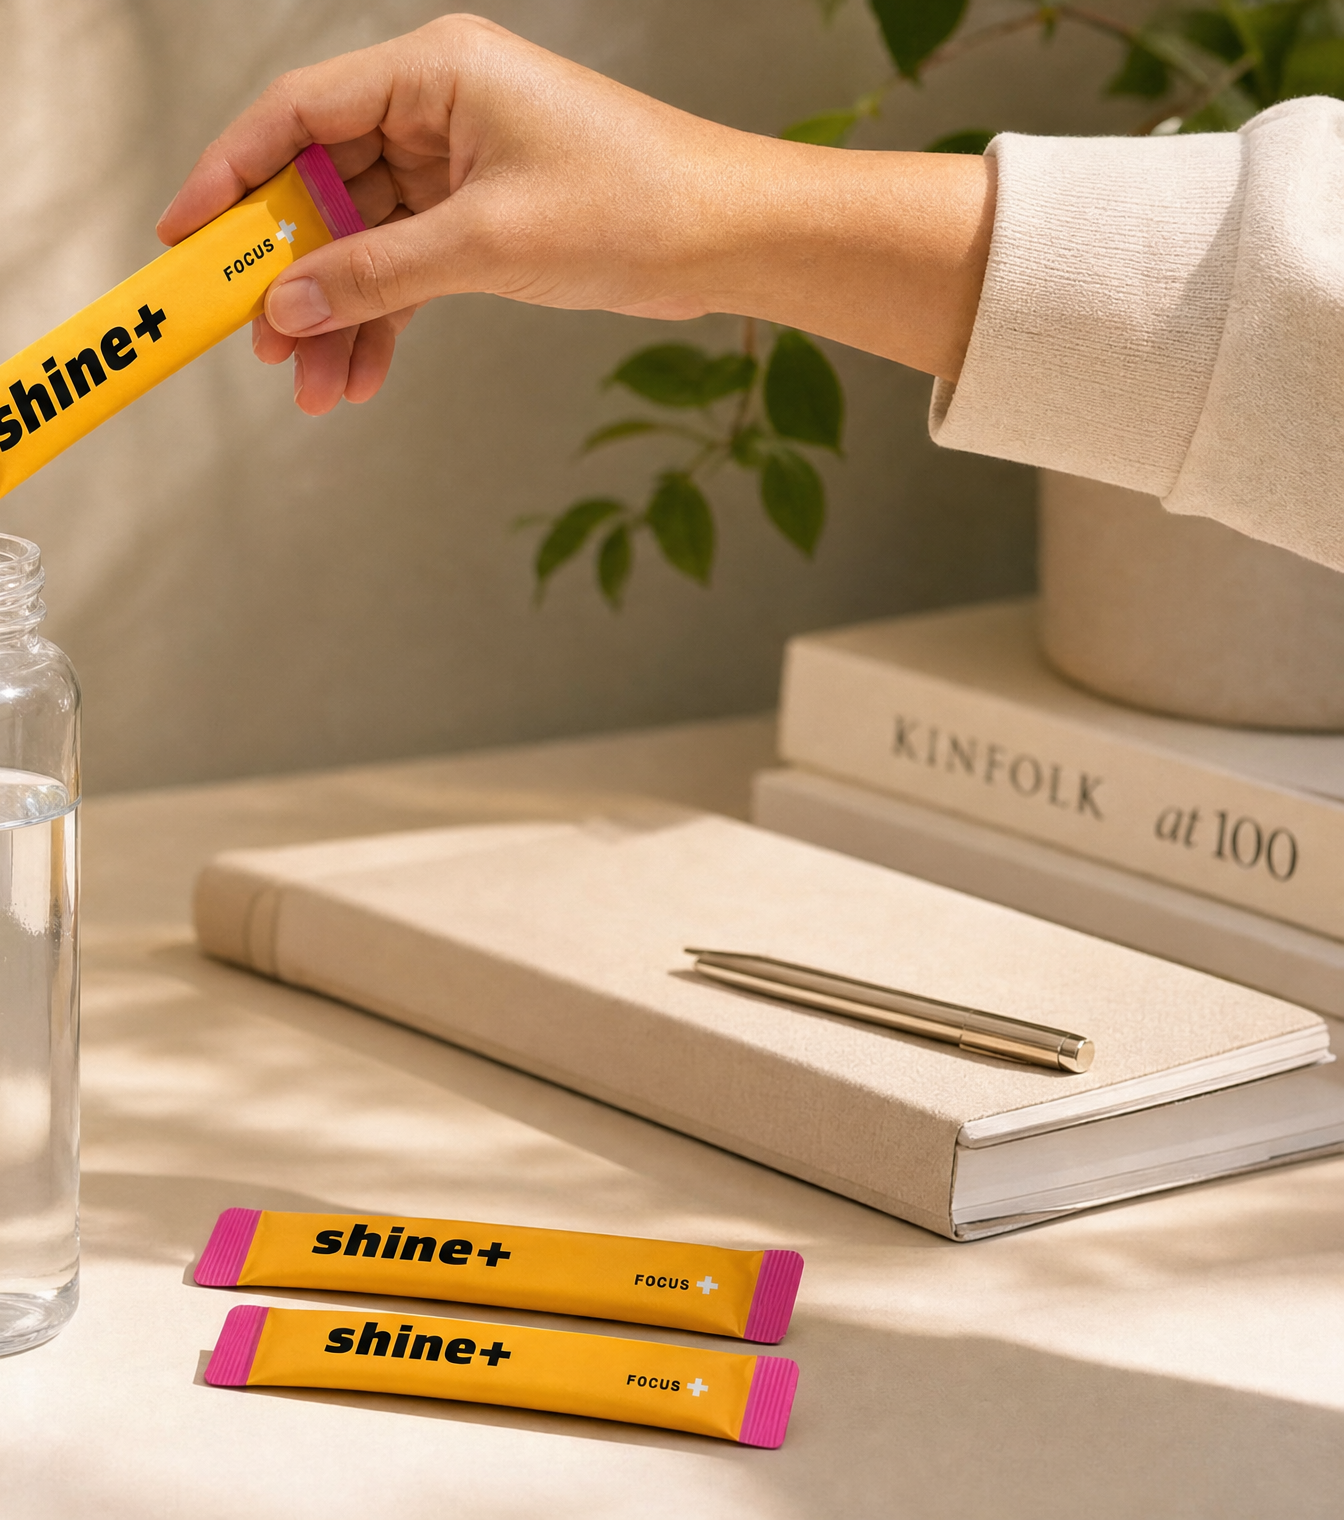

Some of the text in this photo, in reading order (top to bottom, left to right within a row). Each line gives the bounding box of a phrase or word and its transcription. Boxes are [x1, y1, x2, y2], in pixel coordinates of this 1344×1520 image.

[892, 715, 1299, 882] KINFOLK at 100
[311, 1223, 512, 1268] shine+
[324, 1321, 512, 1367] shine+
